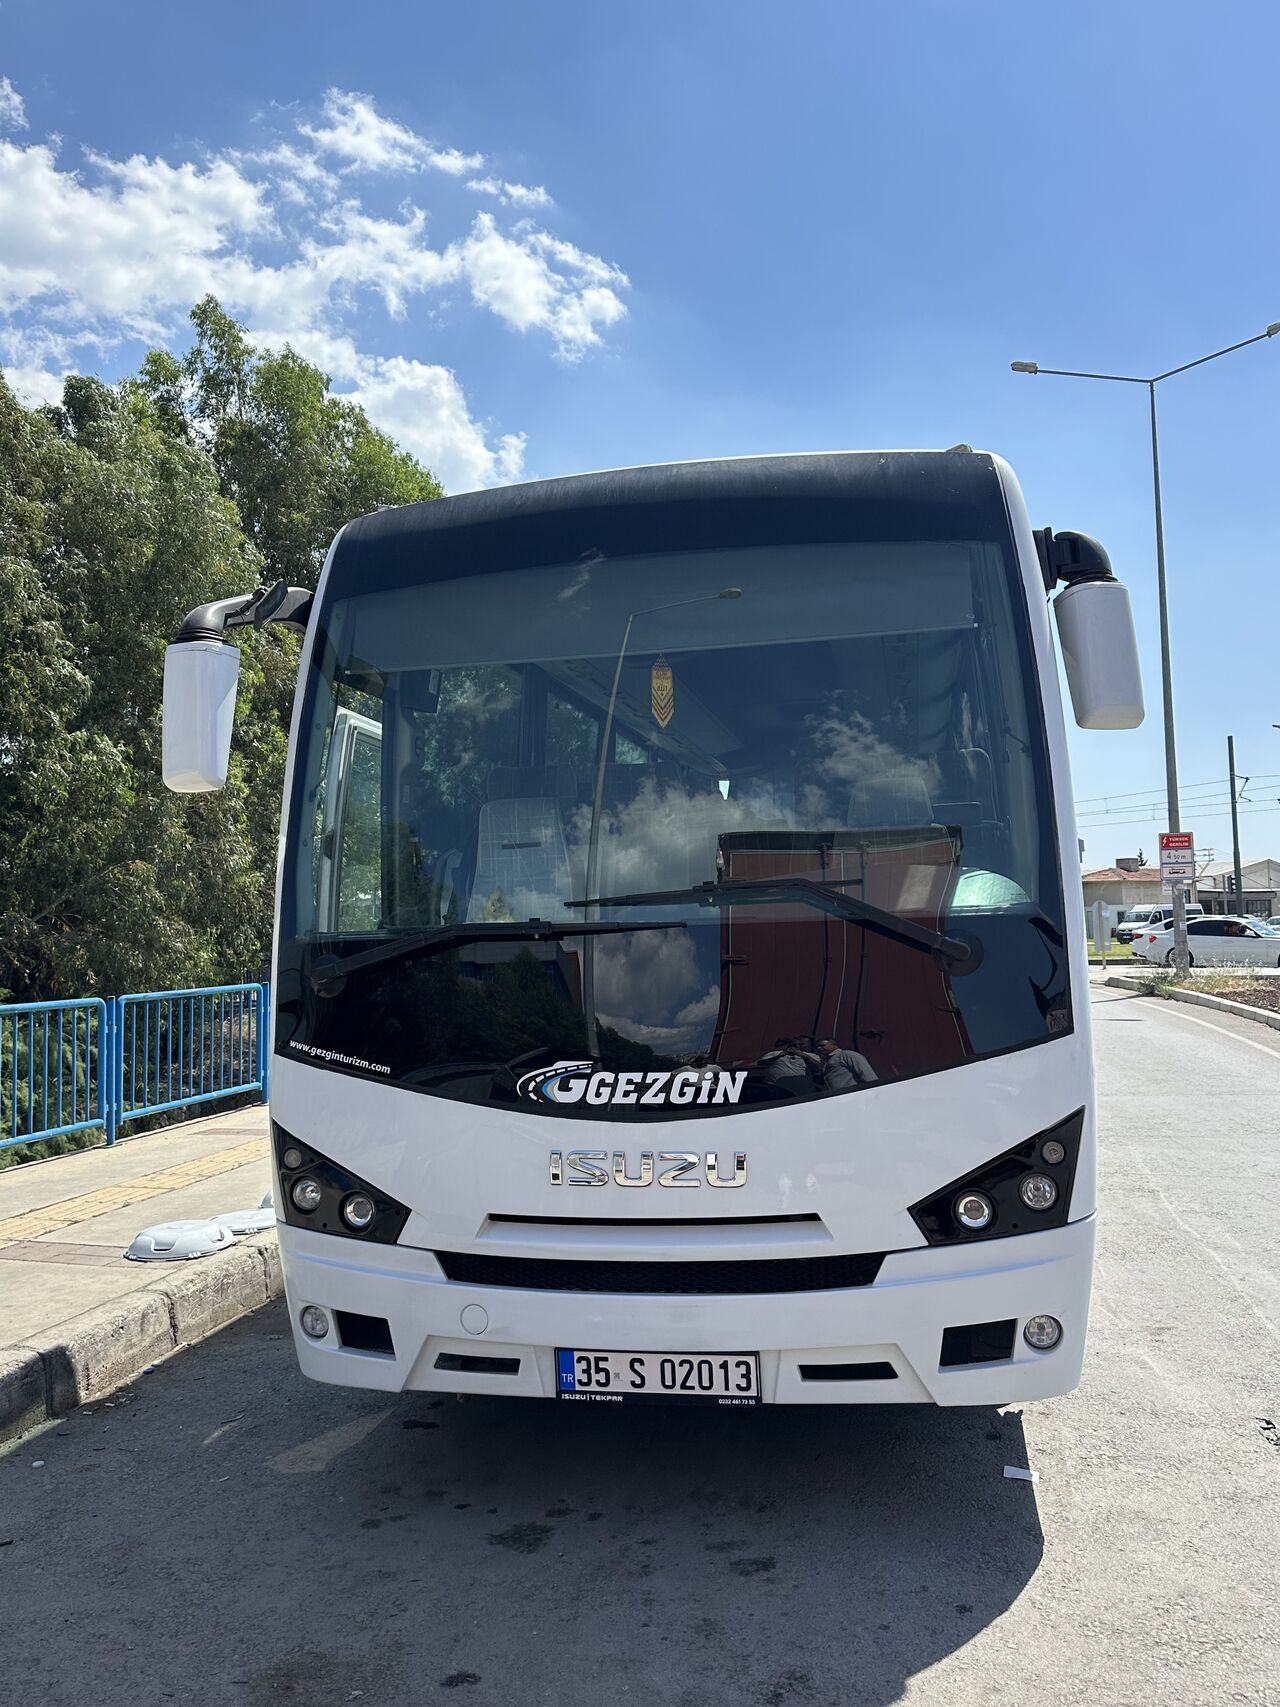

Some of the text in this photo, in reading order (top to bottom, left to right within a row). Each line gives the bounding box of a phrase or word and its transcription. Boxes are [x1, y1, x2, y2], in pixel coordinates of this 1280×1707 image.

[289, 1040, 391, 1074] www.gezginturizm.com
[550, 1151, 748, 1188] ISUZU
[561, 1355, 752, 1392] TR 35 S 02013
[590, 1394, 623, 1402] TEKPAR
